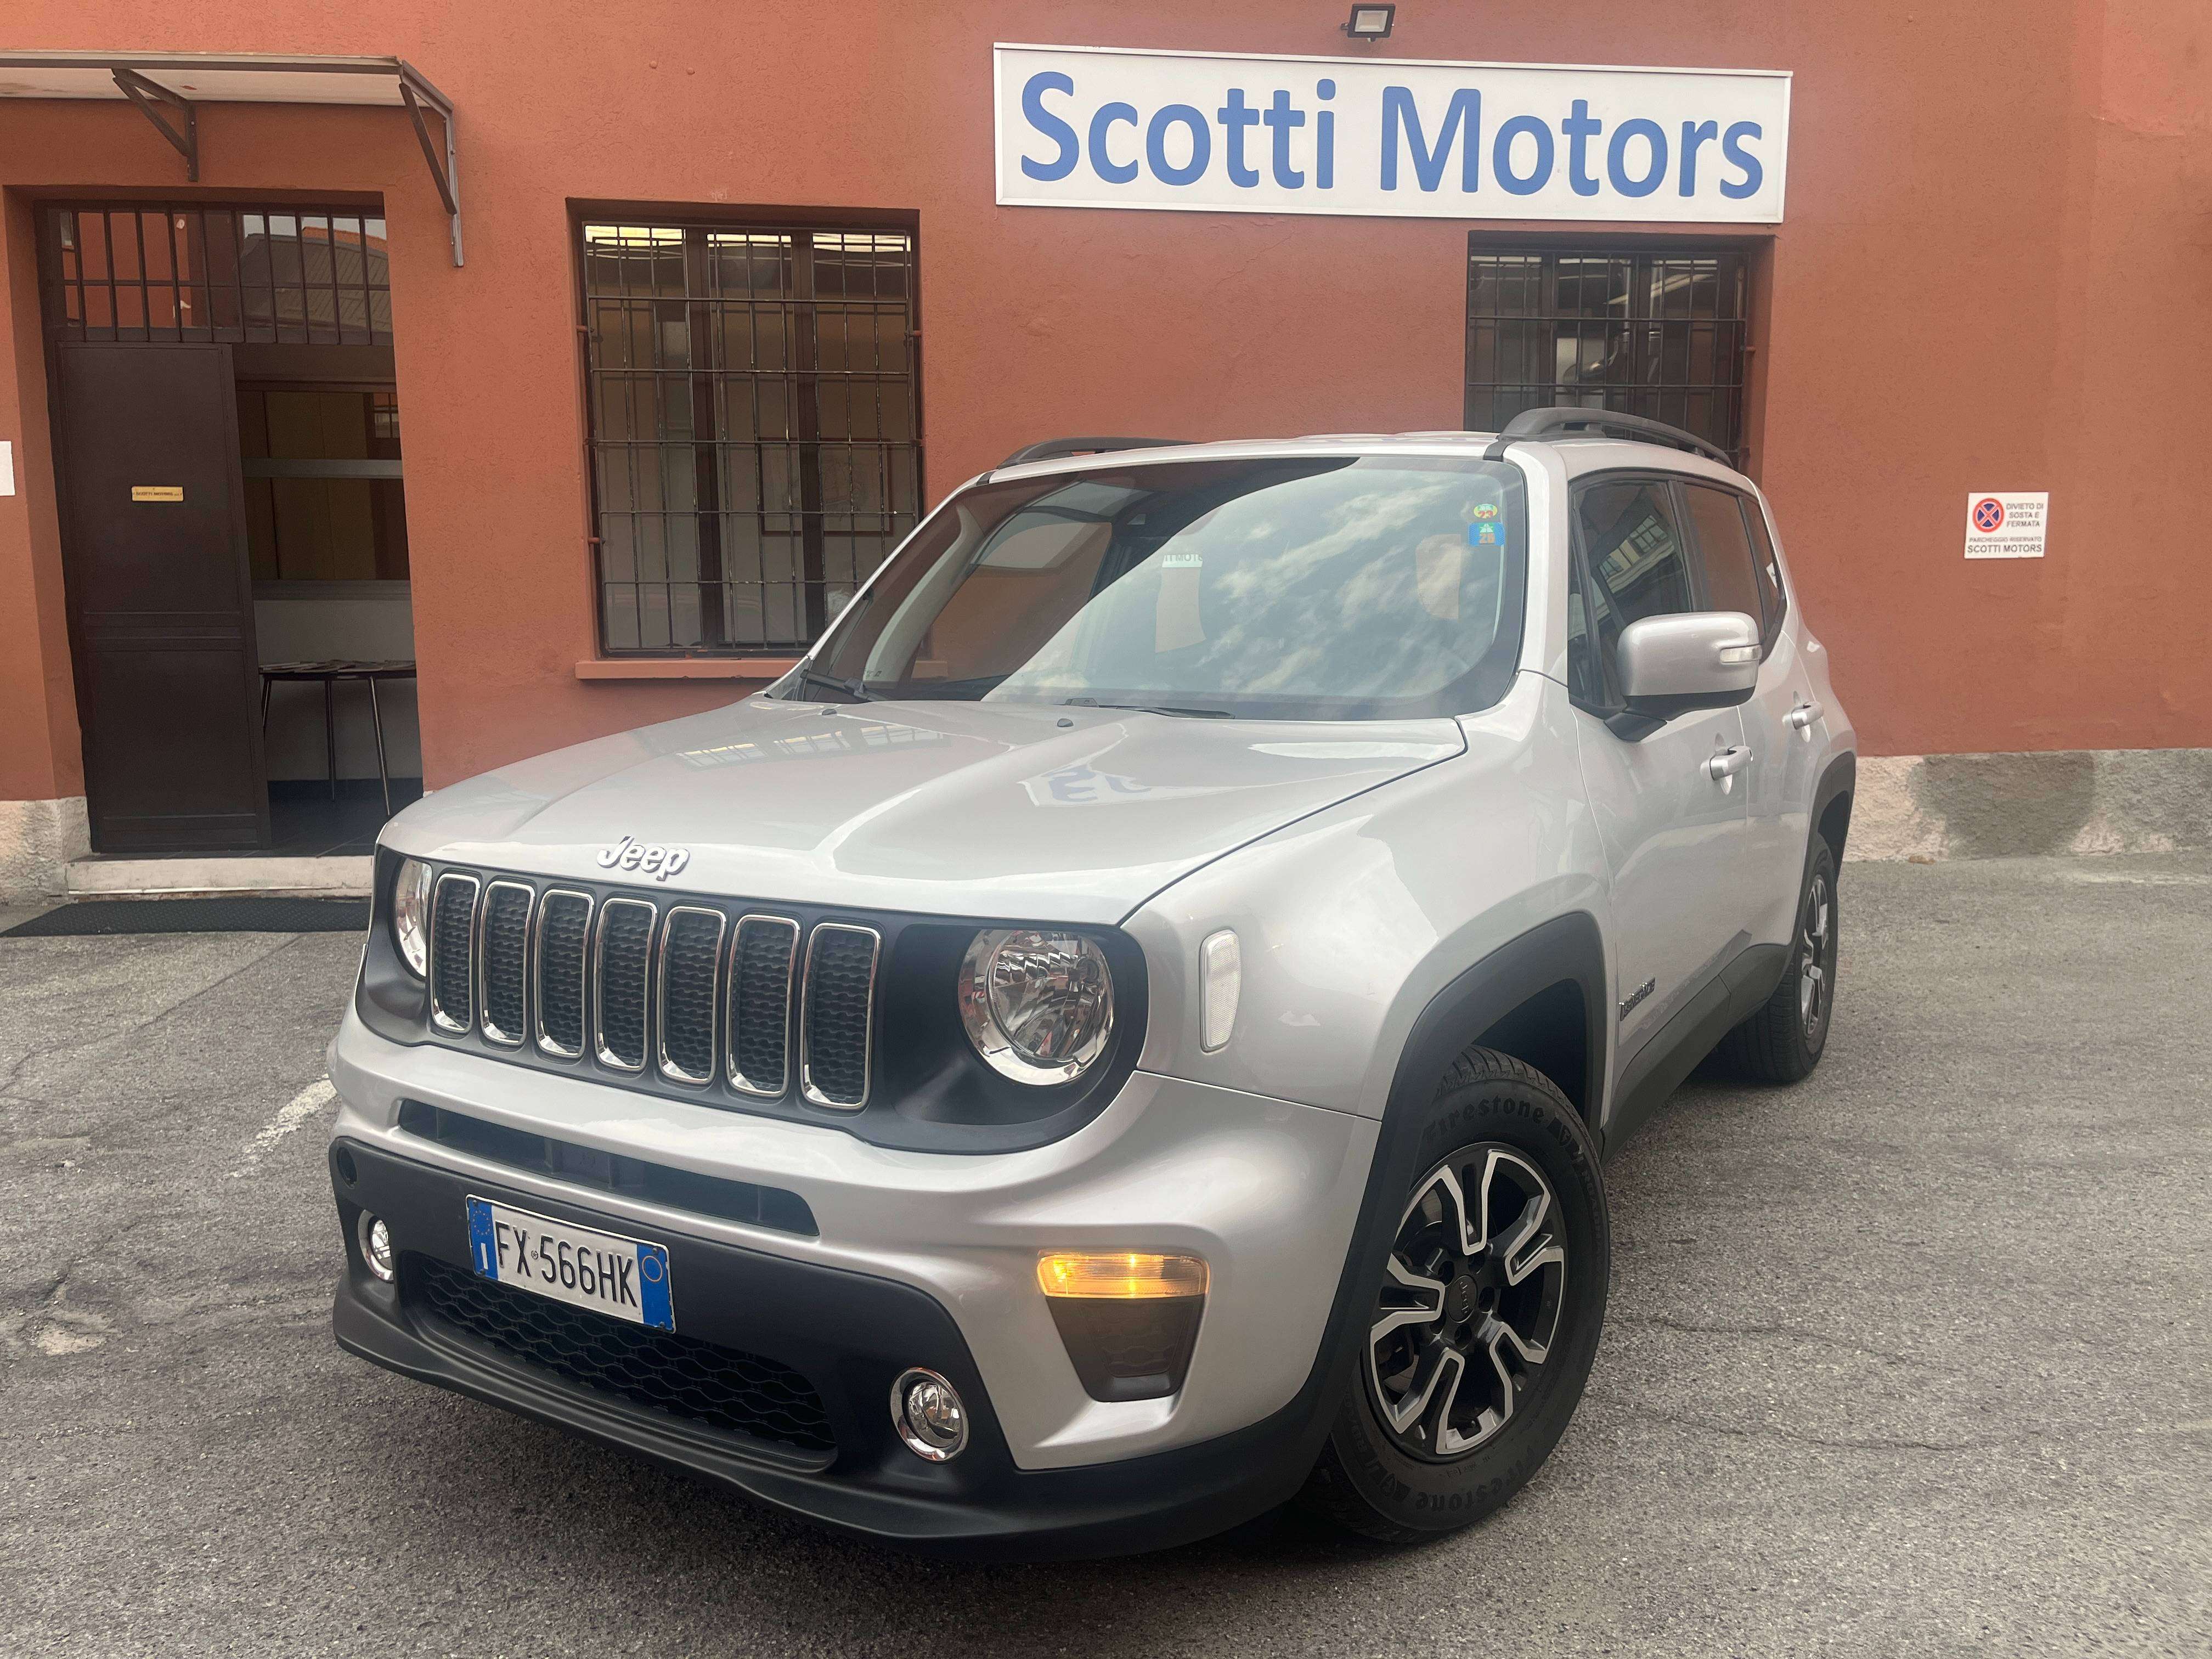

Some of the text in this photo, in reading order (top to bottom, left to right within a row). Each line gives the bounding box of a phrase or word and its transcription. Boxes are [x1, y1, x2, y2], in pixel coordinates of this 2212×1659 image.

[1021, 71, 1764, 199] Scotti Motors
[1967, 544, 2042, 554] SCOTTI MOTORS
[597, 836, 690, 882] Jeep
[495, 1220, 637, 1307] FX 566HK
